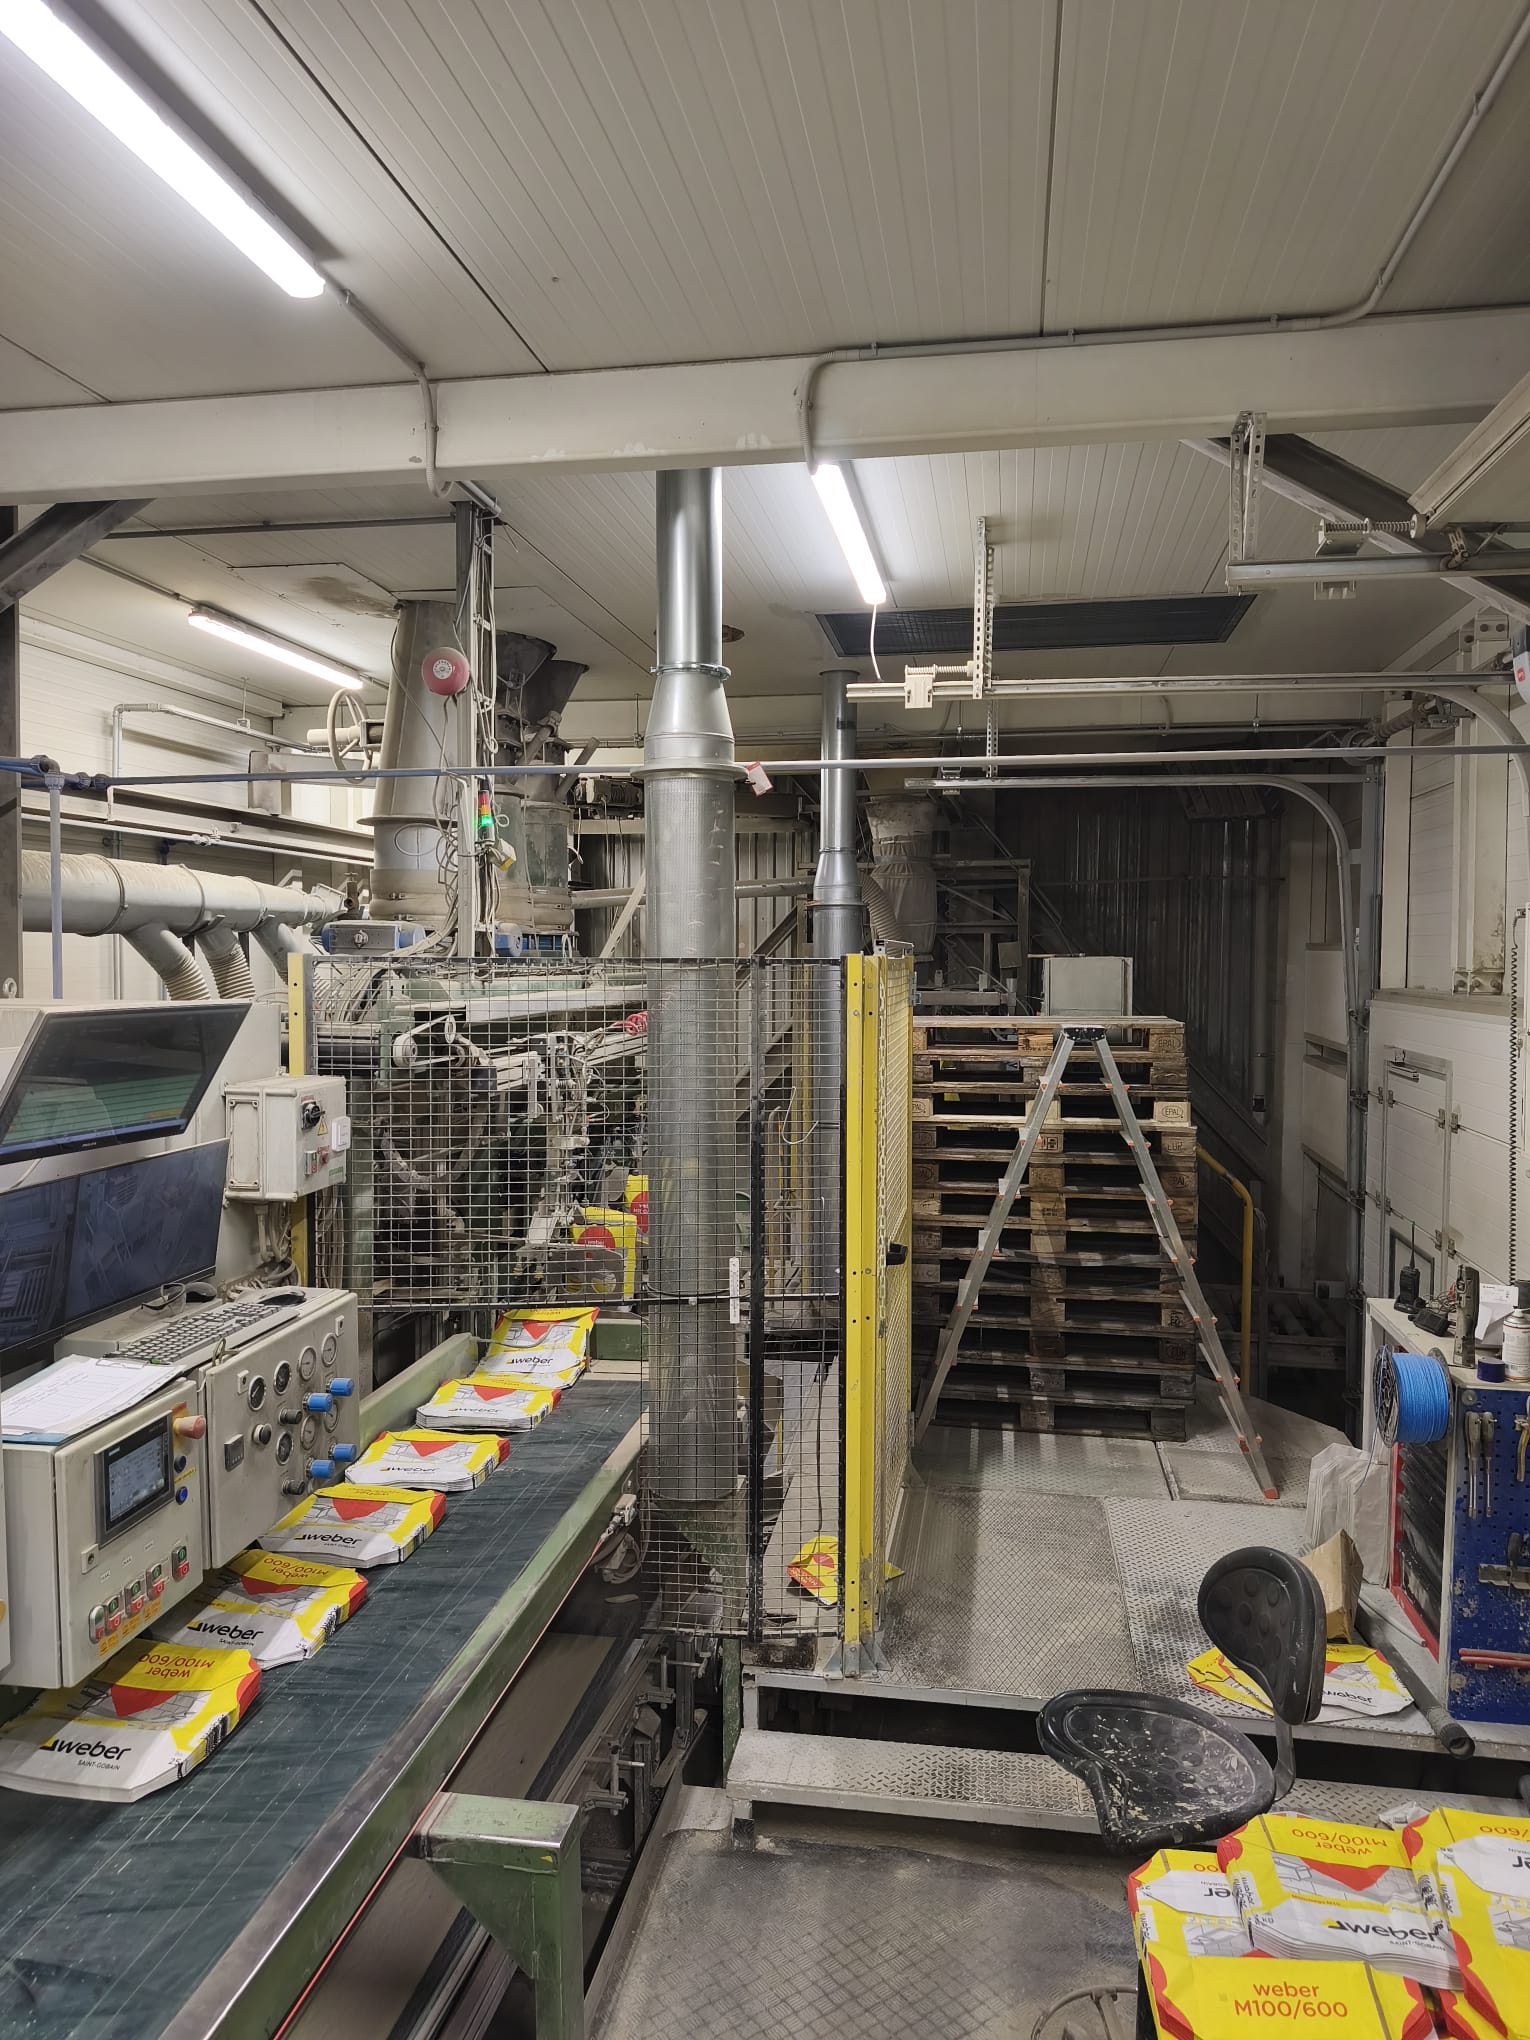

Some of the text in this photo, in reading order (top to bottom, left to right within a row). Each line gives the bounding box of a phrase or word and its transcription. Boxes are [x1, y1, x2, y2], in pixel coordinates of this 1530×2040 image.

[1165, 1108, 1180, 1117] EPAL
[516, 1357, 554, 1365] weber
[306, 1533, 363, 1546] weber
[263, 1557, 330, 1577] M100/600
[269, 1568, 310, 1580] weber
[201, 1623, 265, 1641] weber
[138, 1653, 215, 1669] M100/600
[144, 1667, 190, 1679] weber
[56, 1739, 132, 1761] weber
[77, 1759, 121, 1771] SAINT-GOBAIN
[1291, 1827, 1387, 1848] M100/600
[1314, 1839, 1372, 1855] weber
[1342, 1918, 1438, 1941] weber
[1389, 1939, 1447, 1953] SAINT-GOBAIN
[1253, 1981, 1320, 1999] weber
[1233, 1999, 1349, 2020] M100/600
